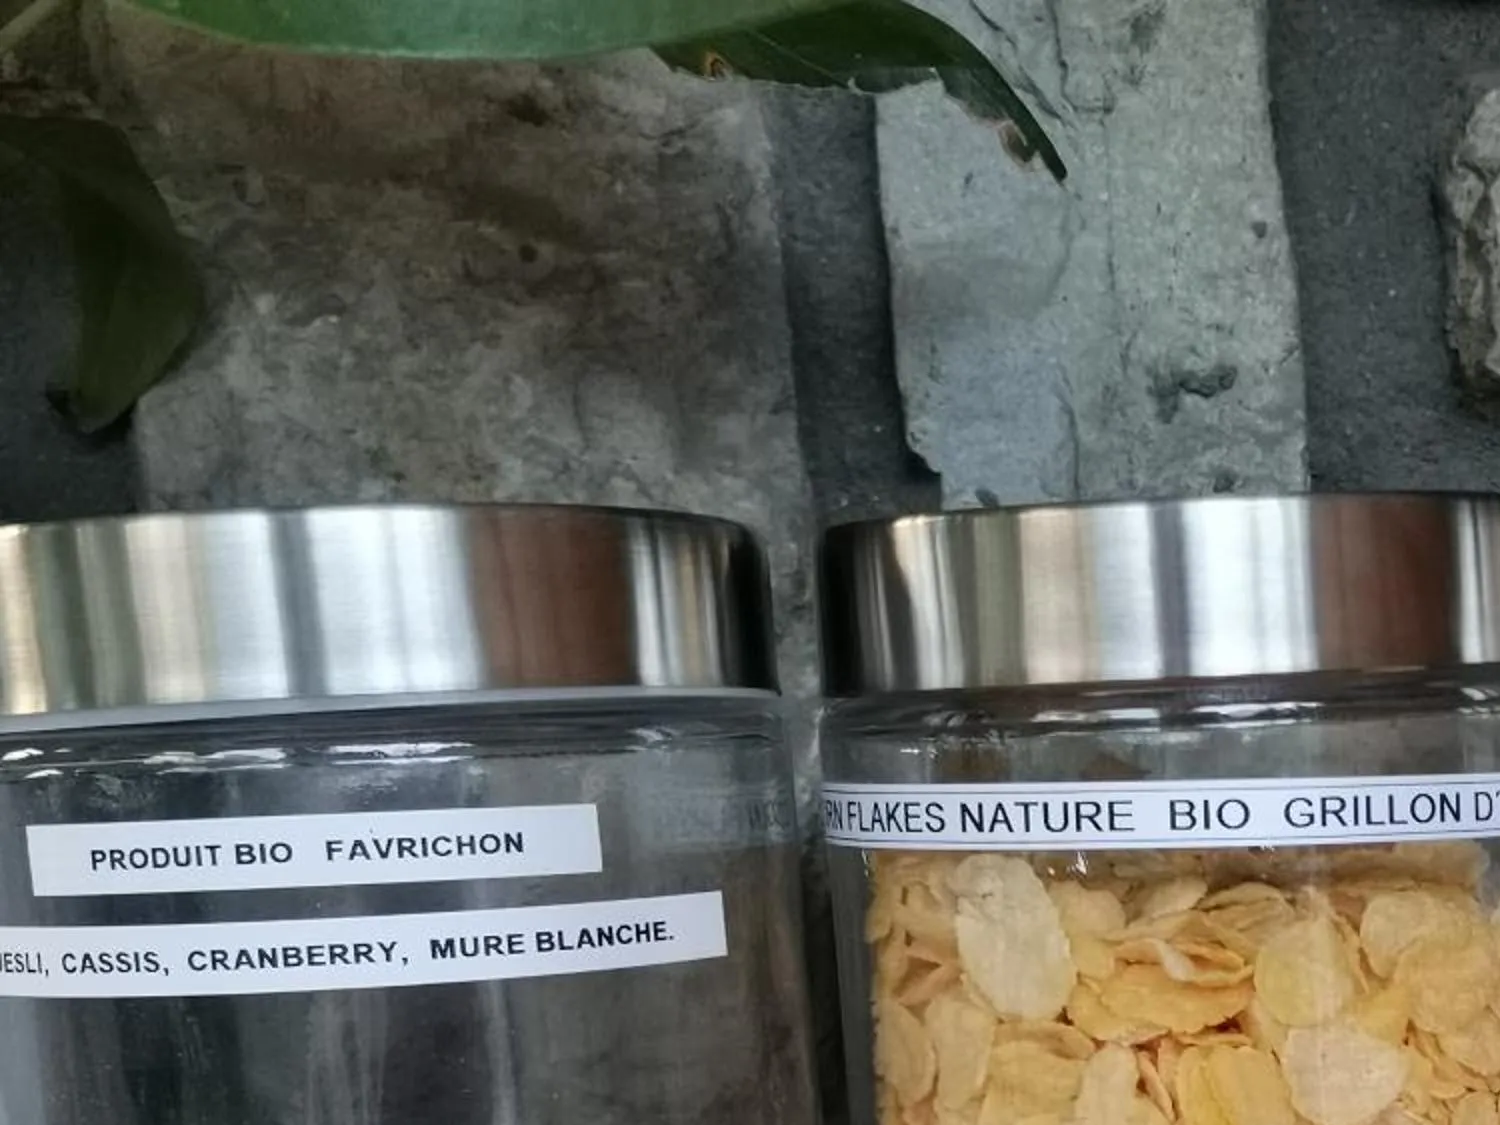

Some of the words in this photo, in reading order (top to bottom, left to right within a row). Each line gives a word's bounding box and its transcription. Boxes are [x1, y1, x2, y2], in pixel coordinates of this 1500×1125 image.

[847, 801, 945, 833] FLAKES
[960, 801, 1135, 833] NATURE
[1170, 798, 1250, 830] BIO
[1284, 793, 1461, 827] GRILLON
[90, 843, 222, 871] PRODUIT
[234, 840, 292, 866] BIO
[326, 831, 524, 861] FAVRICHON
[0, 951, 49, 977] ESLI,
[61, 951, 169, 976] CASSIS,
[187, 940, 408, 971] CRANBERRY,
[430, 931, 523, 959] MURE
[535, 921, 674, 953] BLANCHE.
